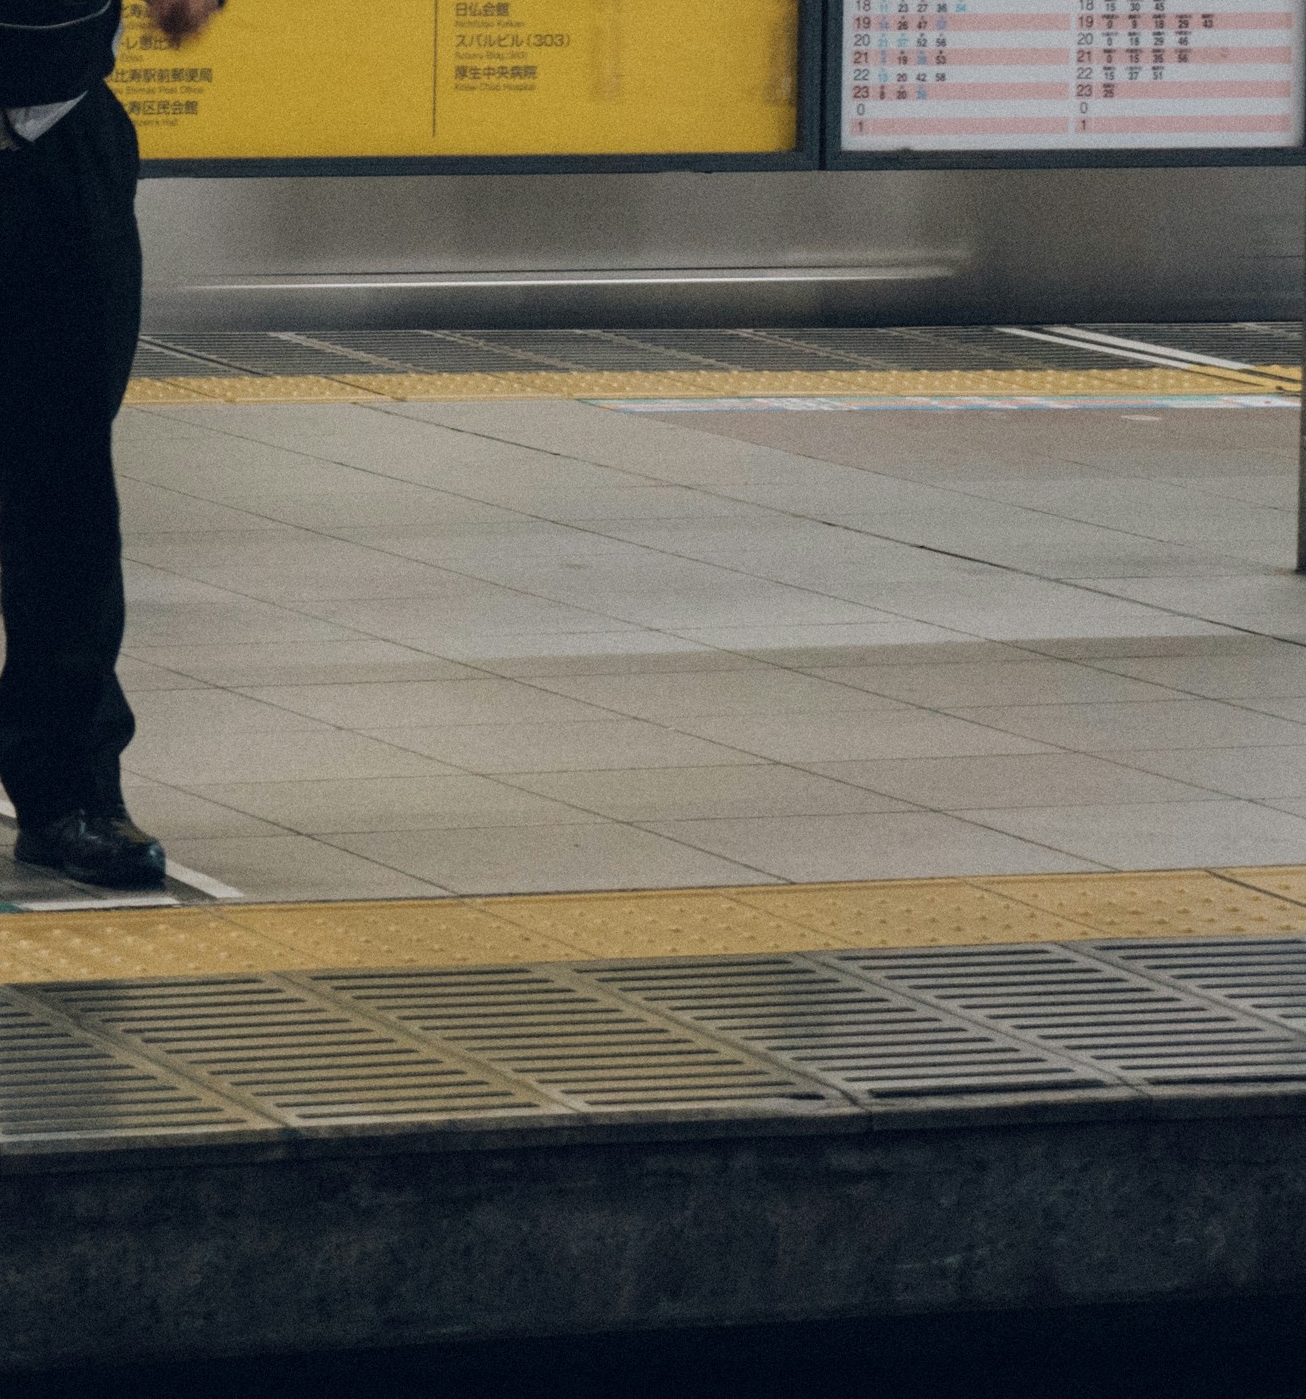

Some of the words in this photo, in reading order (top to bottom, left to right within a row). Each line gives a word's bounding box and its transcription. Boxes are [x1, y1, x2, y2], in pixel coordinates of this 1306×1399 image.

[855, 17, 871, 29] 19
[106, 67, 213, 83] 比寿駅前郵便局
[853, 86, 869, 99] 23
[126, 100, 199, 116] 寿区民会館
